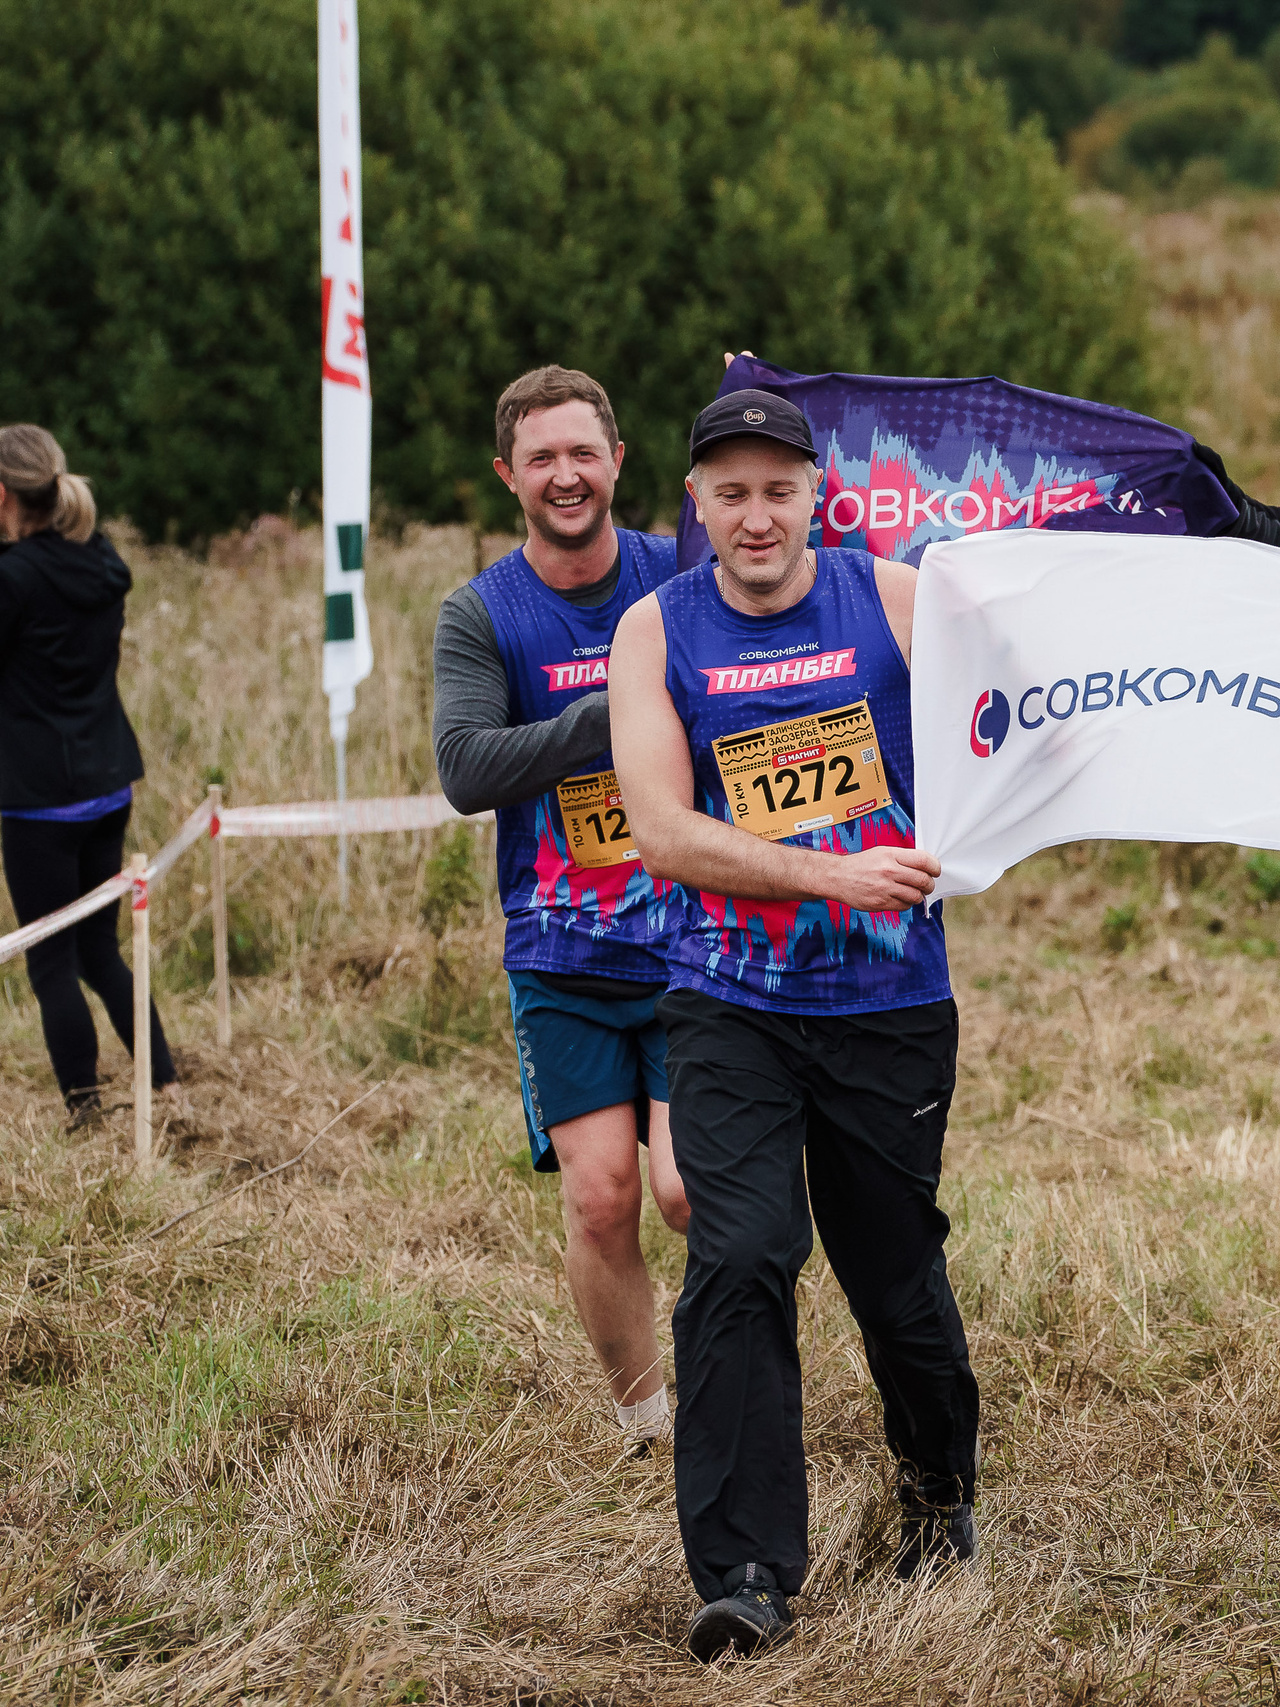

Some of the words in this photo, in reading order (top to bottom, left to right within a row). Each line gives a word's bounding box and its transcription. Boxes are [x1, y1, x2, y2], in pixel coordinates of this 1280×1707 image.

[746, 411, 764, 422] Buff
[739, 642, 819, 660] СОВКОМБАНК
[715, 652, 850, 690] ПЛАНБЕГ
[766, 718, 817, 737] ГАЛИЧСКОЕ
[768, 726, 819, 746] ЗАОЗЕРЬЕ
[771, 744, 796, 756] день
[798, 738, 821, 748] бега
[787, 748, 820, 762] МАГНИТ
[733, 781, 747, 801] КМ
[751, 754, 861, 814] 1272
[735, 802, 750, 820] 10
[571, 818, 581, 833] КМ
[585, 807, 631, 844] 12
[572, 835, 585, 849] 10
